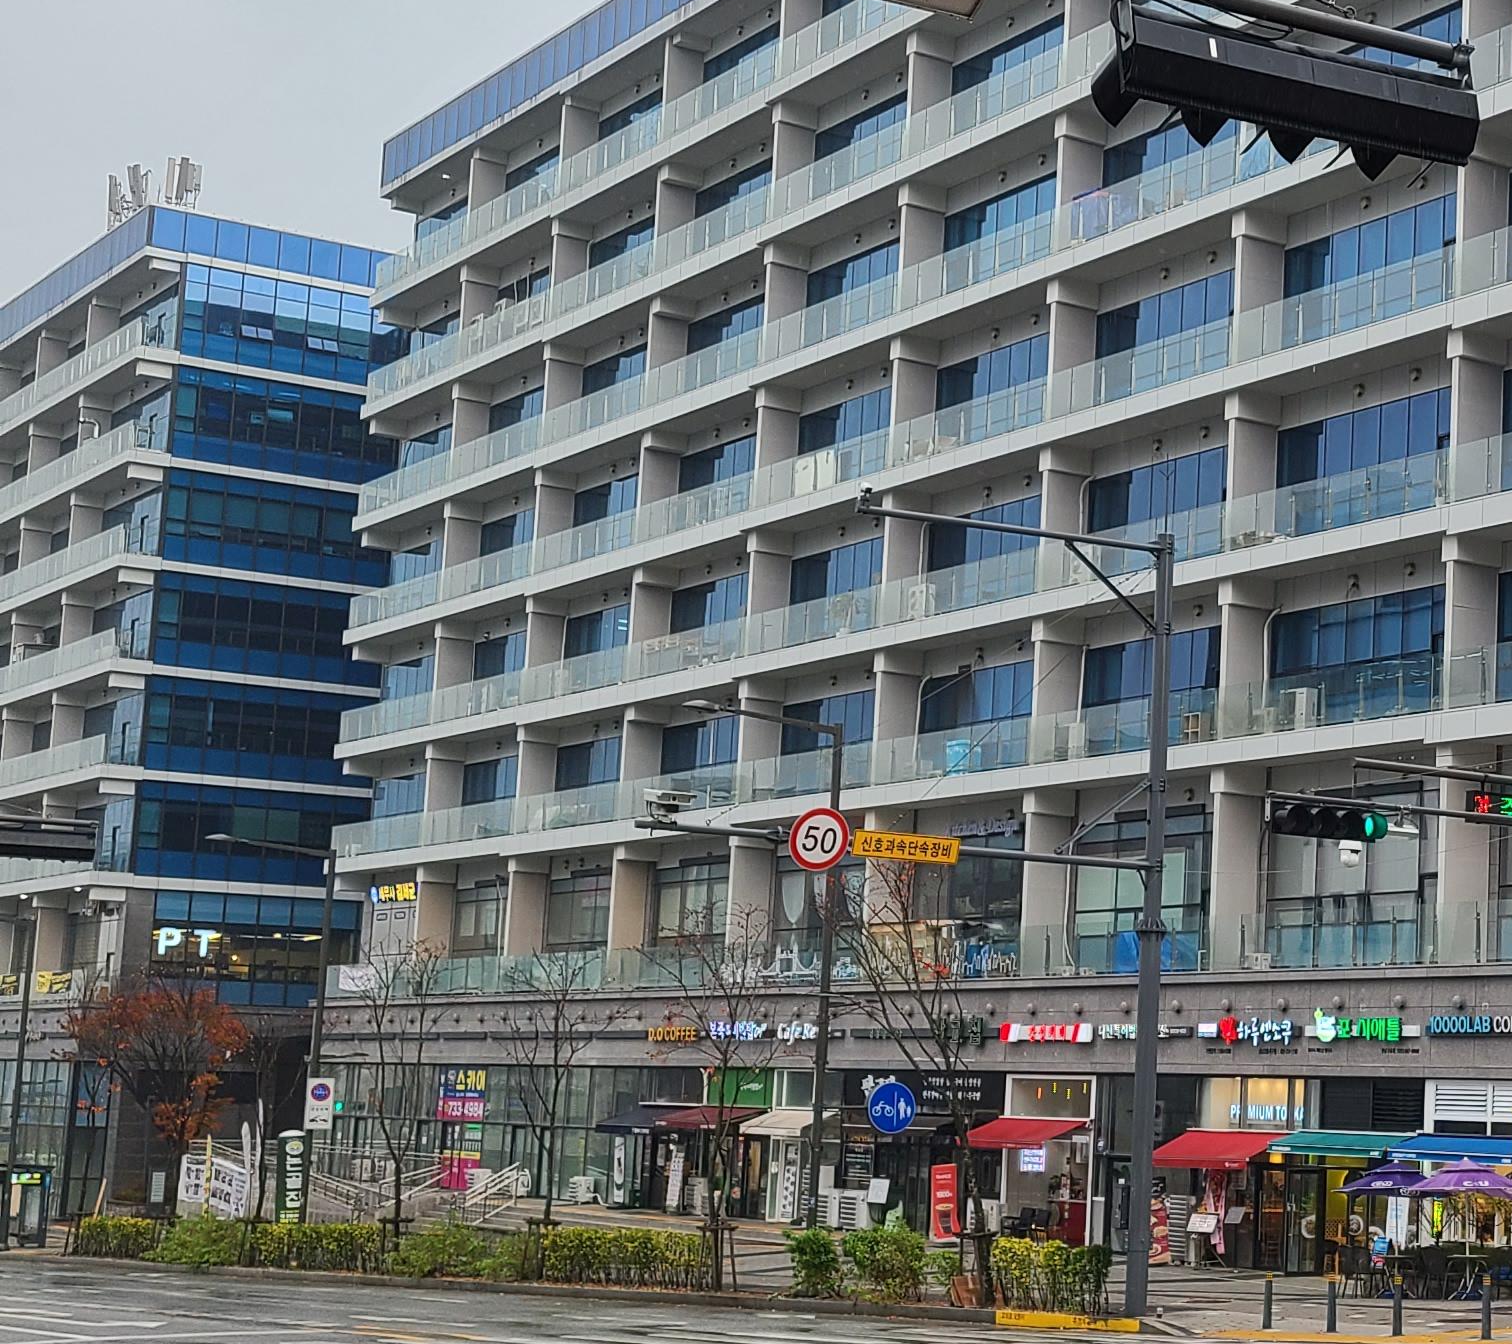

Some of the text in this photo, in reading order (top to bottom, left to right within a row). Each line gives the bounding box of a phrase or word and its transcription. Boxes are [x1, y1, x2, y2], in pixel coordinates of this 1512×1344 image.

[802, 826, 837, 854] 50
[861, 836, 953, 859] 신호과속단속장비
[664, 1026, 698, 1041] COFFEE
[1430, 1015, 1491, 1034] 10000LAB
[1230, 1104, 1273, 1121] PRMIUM
